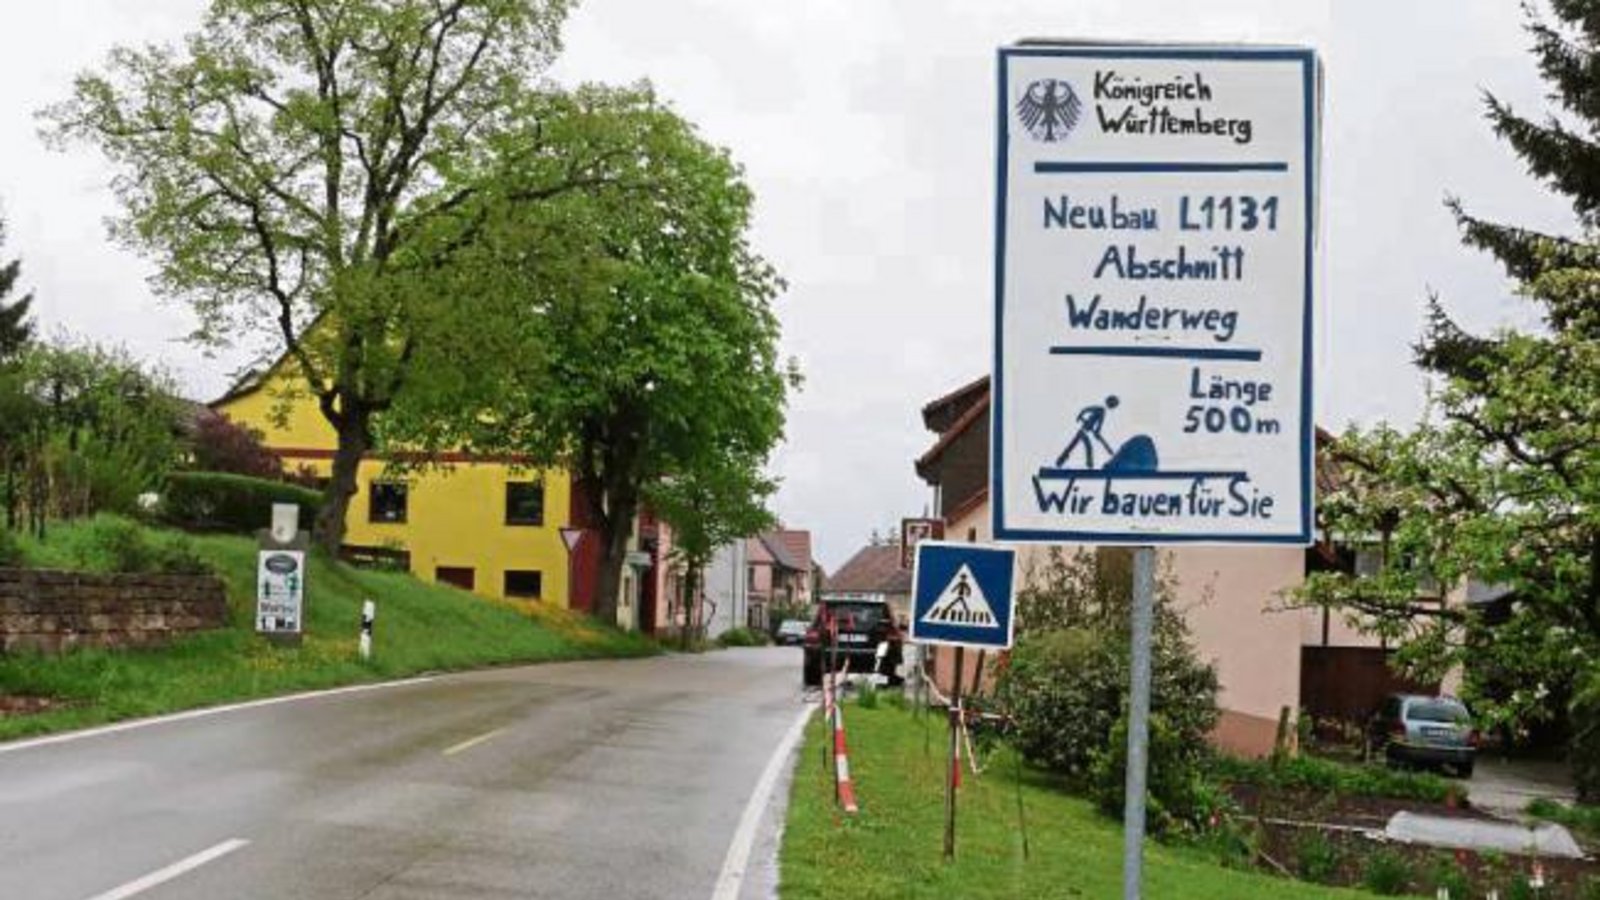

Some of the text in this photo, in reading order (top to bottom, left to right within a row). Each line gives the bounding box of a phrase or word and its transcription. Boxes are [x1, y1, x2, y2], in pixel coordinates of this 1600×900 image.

[1093, 70, 1212, 106] Königreich
[1096, 105, 1252, 144] Württemberg
[1043, 195, 1279, 231] Neubau L1131
[1093, 245, 1245, 280] Abschnitt
[1066, 294, 1238, 342] Wanderweg
[1190, 367, 1273, 405] Länge
[1032, 475, 1274, 518] Wir bauen für Sie
